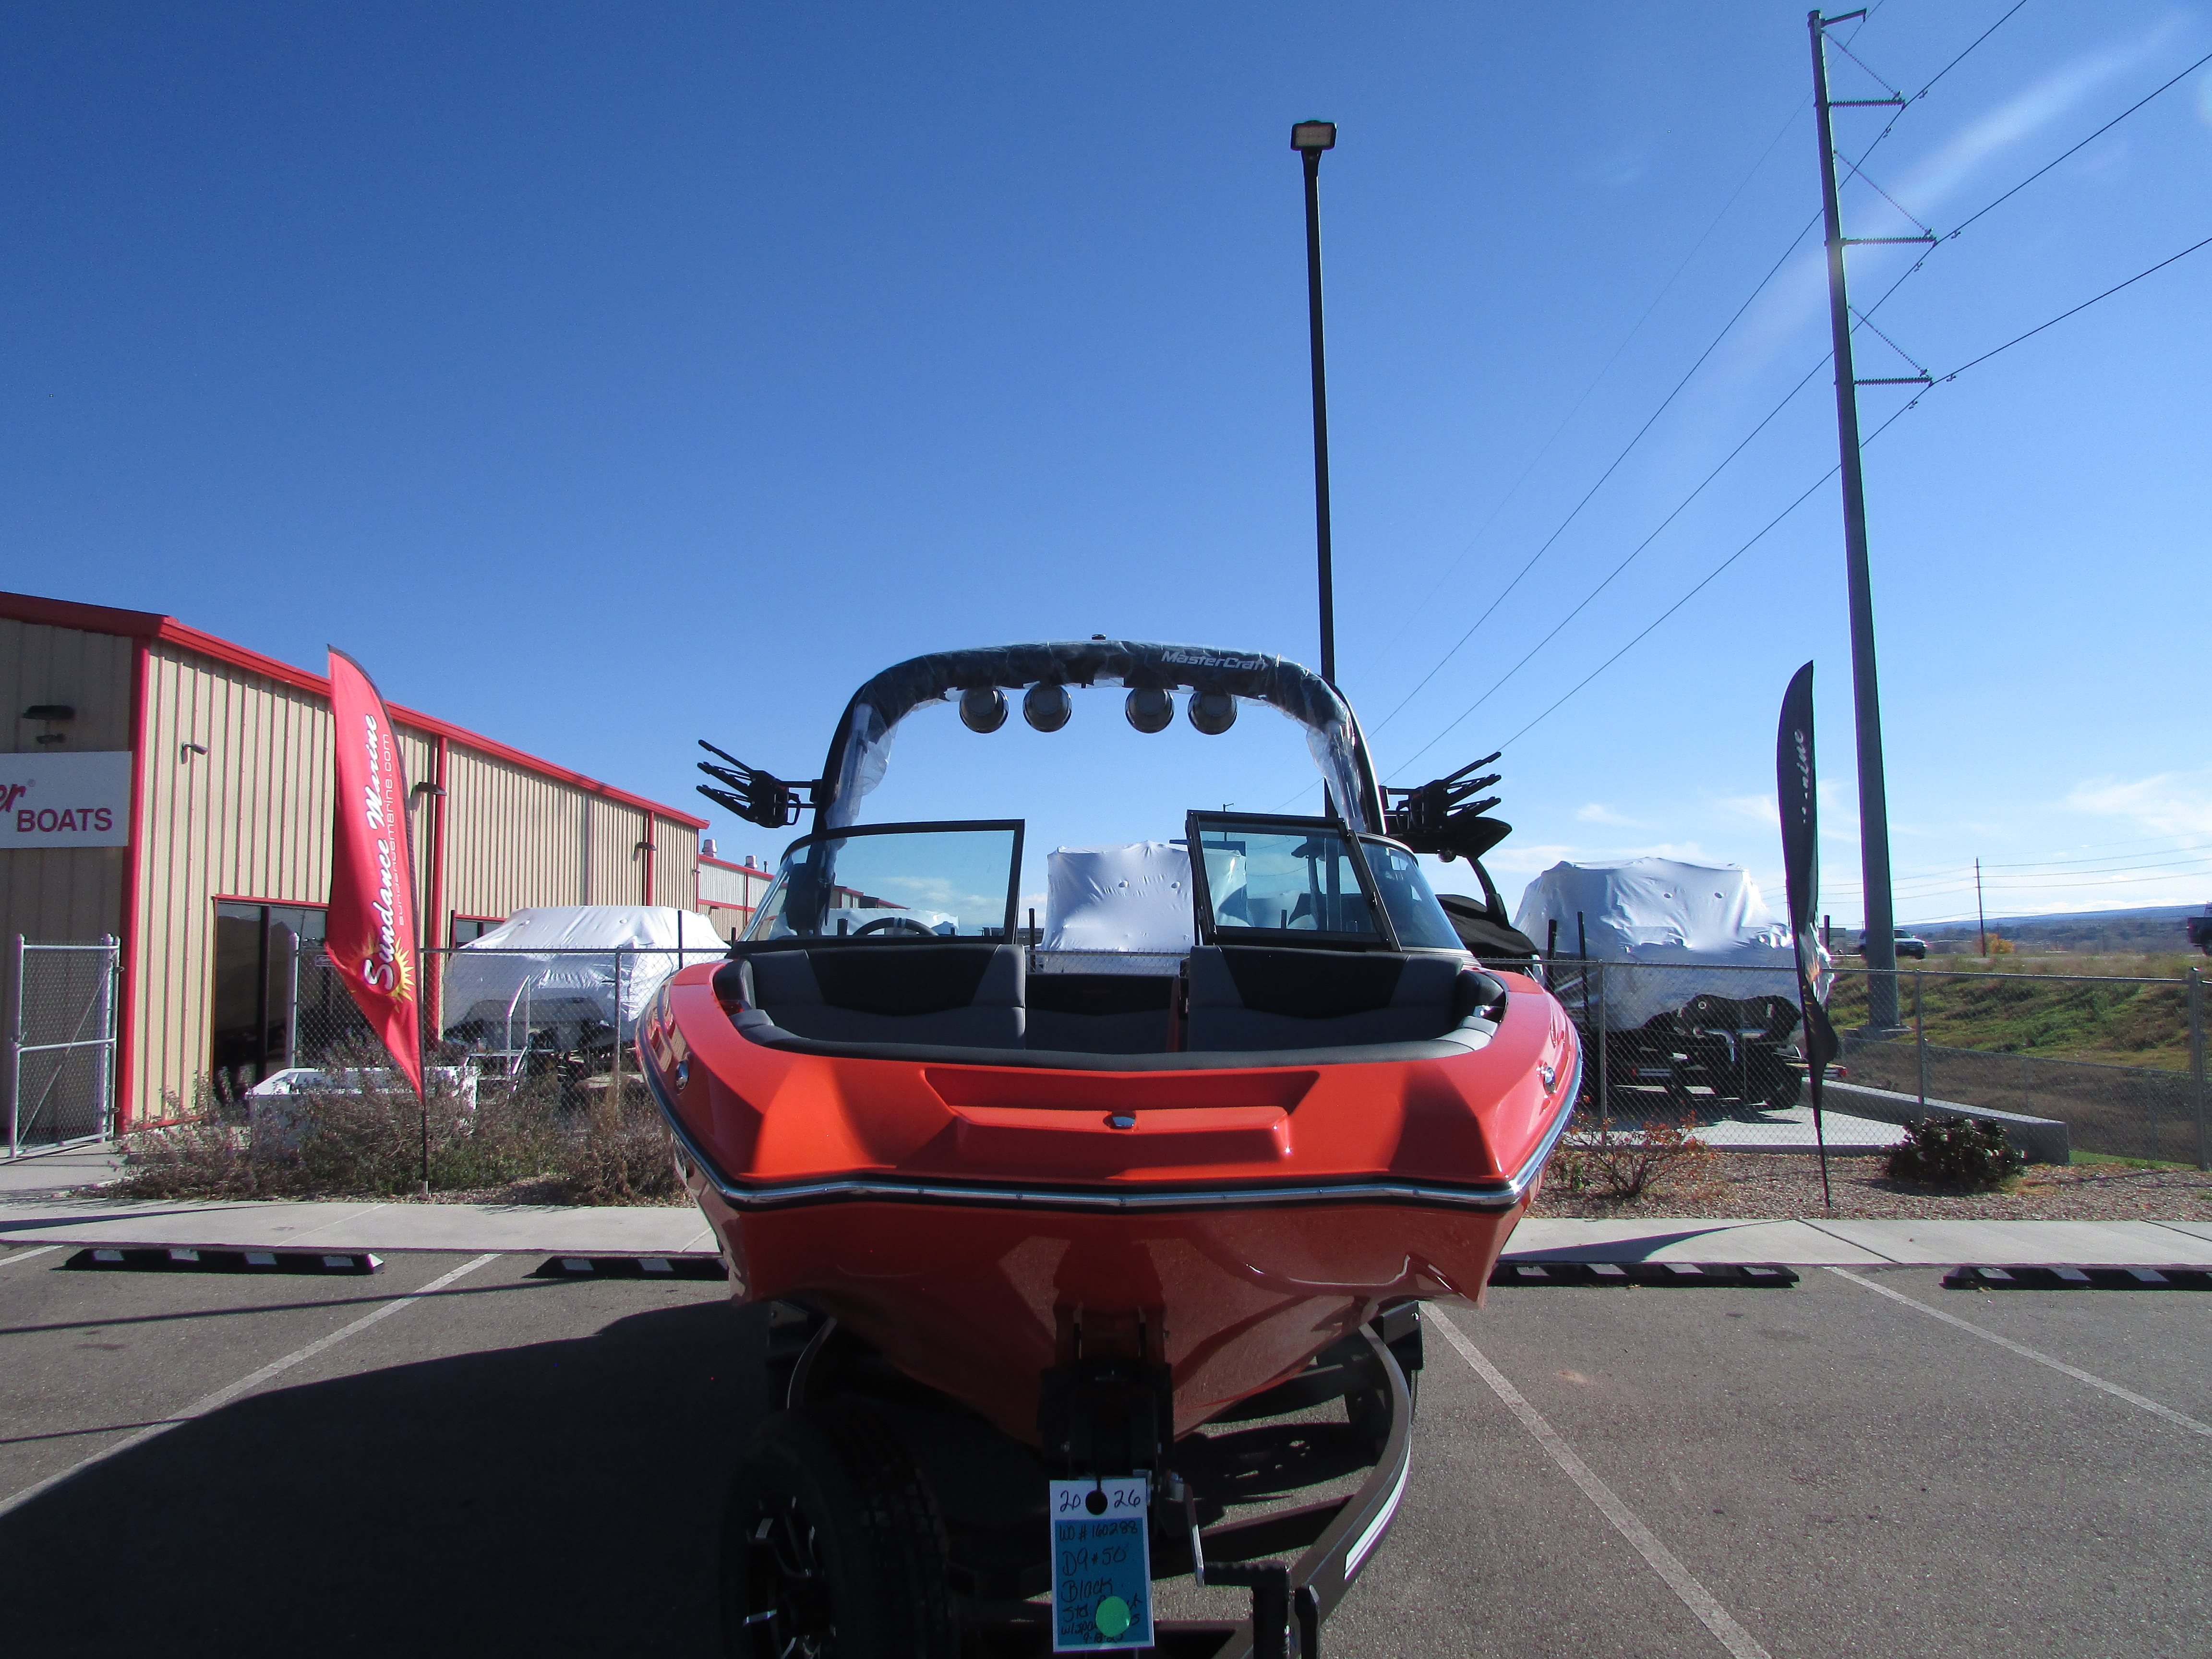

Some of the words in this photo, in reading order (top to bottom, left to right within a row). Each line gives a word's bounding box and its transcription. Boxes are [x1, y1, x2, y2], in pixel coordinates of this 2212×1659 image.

[17, 808, 113, 832] BOATS
[365, 713, 385, 830] Marine
[363, 839, 395, 990] Sundance
